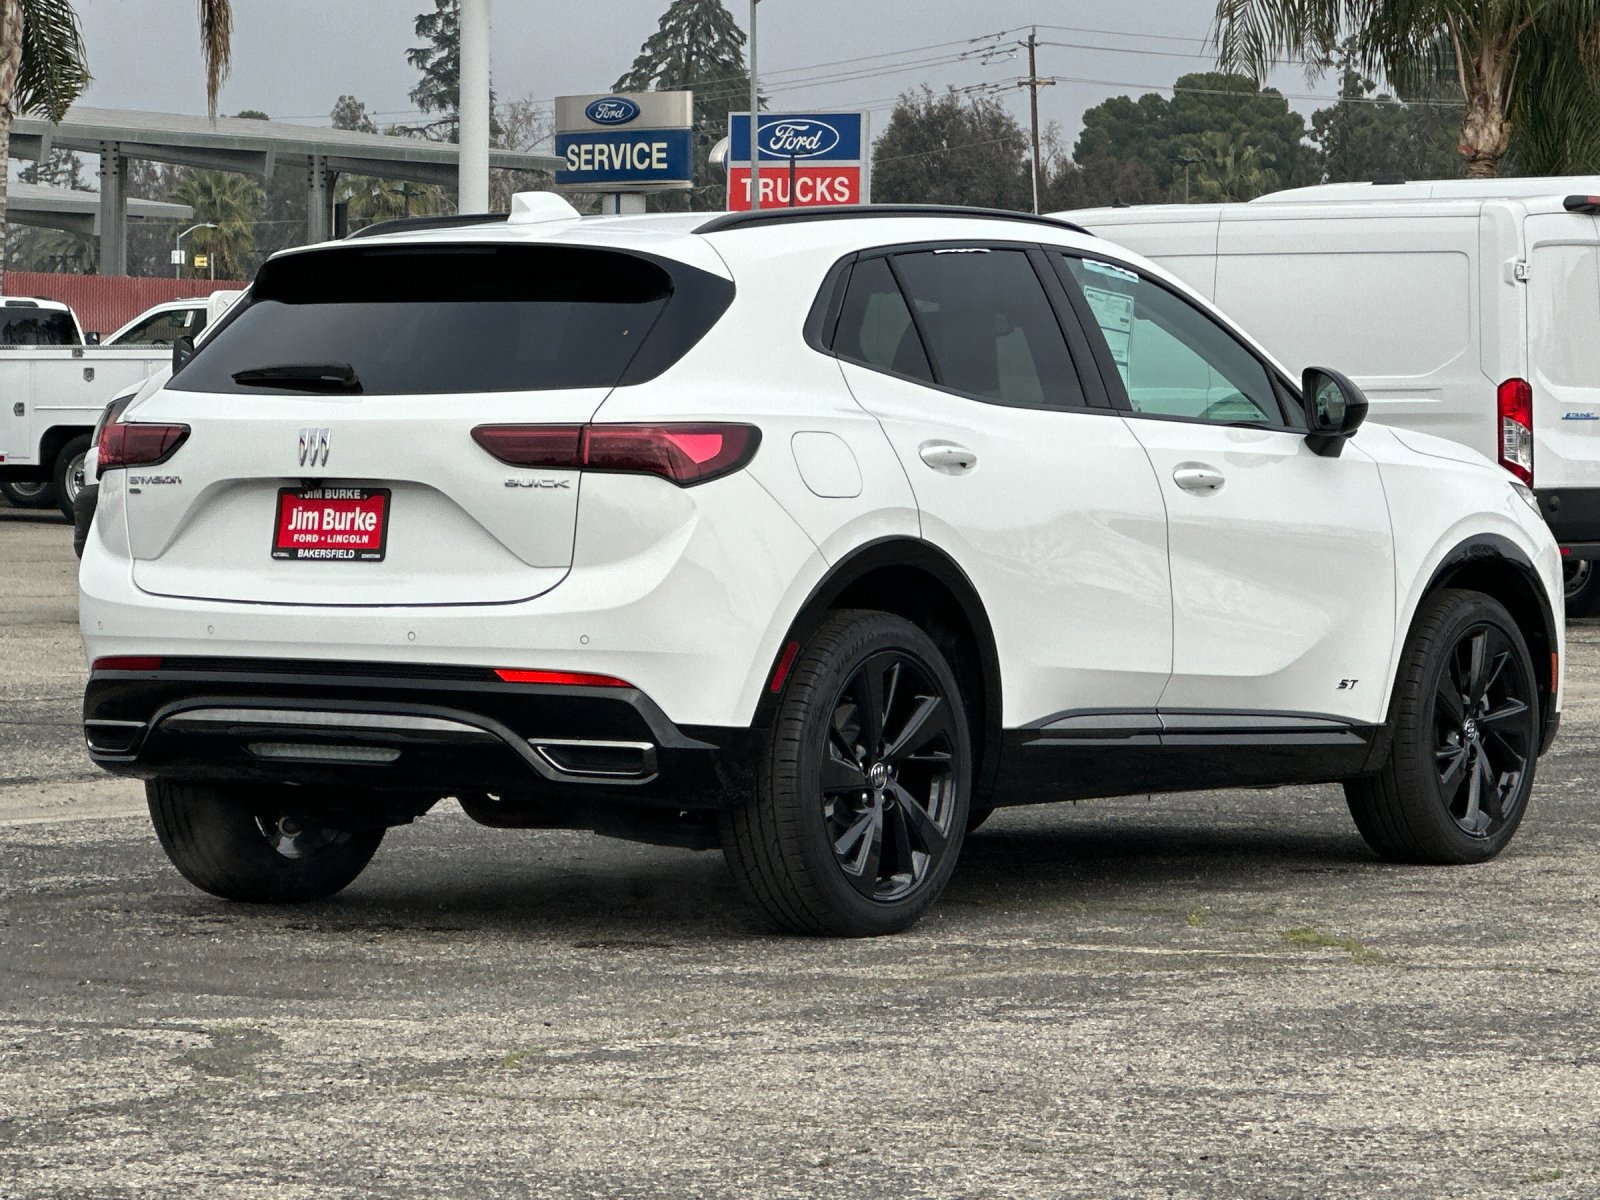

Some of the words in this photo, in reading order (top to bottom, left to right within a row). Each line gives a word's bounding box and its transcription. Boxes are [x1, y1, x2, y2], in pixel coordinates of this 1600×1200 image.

[595, 103, 624, 118] Ford
[769, 124, 822, 150] Ford
[566, 142, 668, 171] SERVICE
[740, 176, 850, 202] TRUCKS
[504, 479, 570, 488] BUICK
[304, 489, 322, 499] JIM
[325, 489, 360, 499] BURKE
[288, 506, 319, 531] Jim
[322, 506, 377, 531] Burke
[293, 533, 319, 543] FORD
[327, 534, 369, 544] LINCOLN
[297, 549, 355, 559] BAKERSFIELD
[1336, 679, 1359, 690] ST
